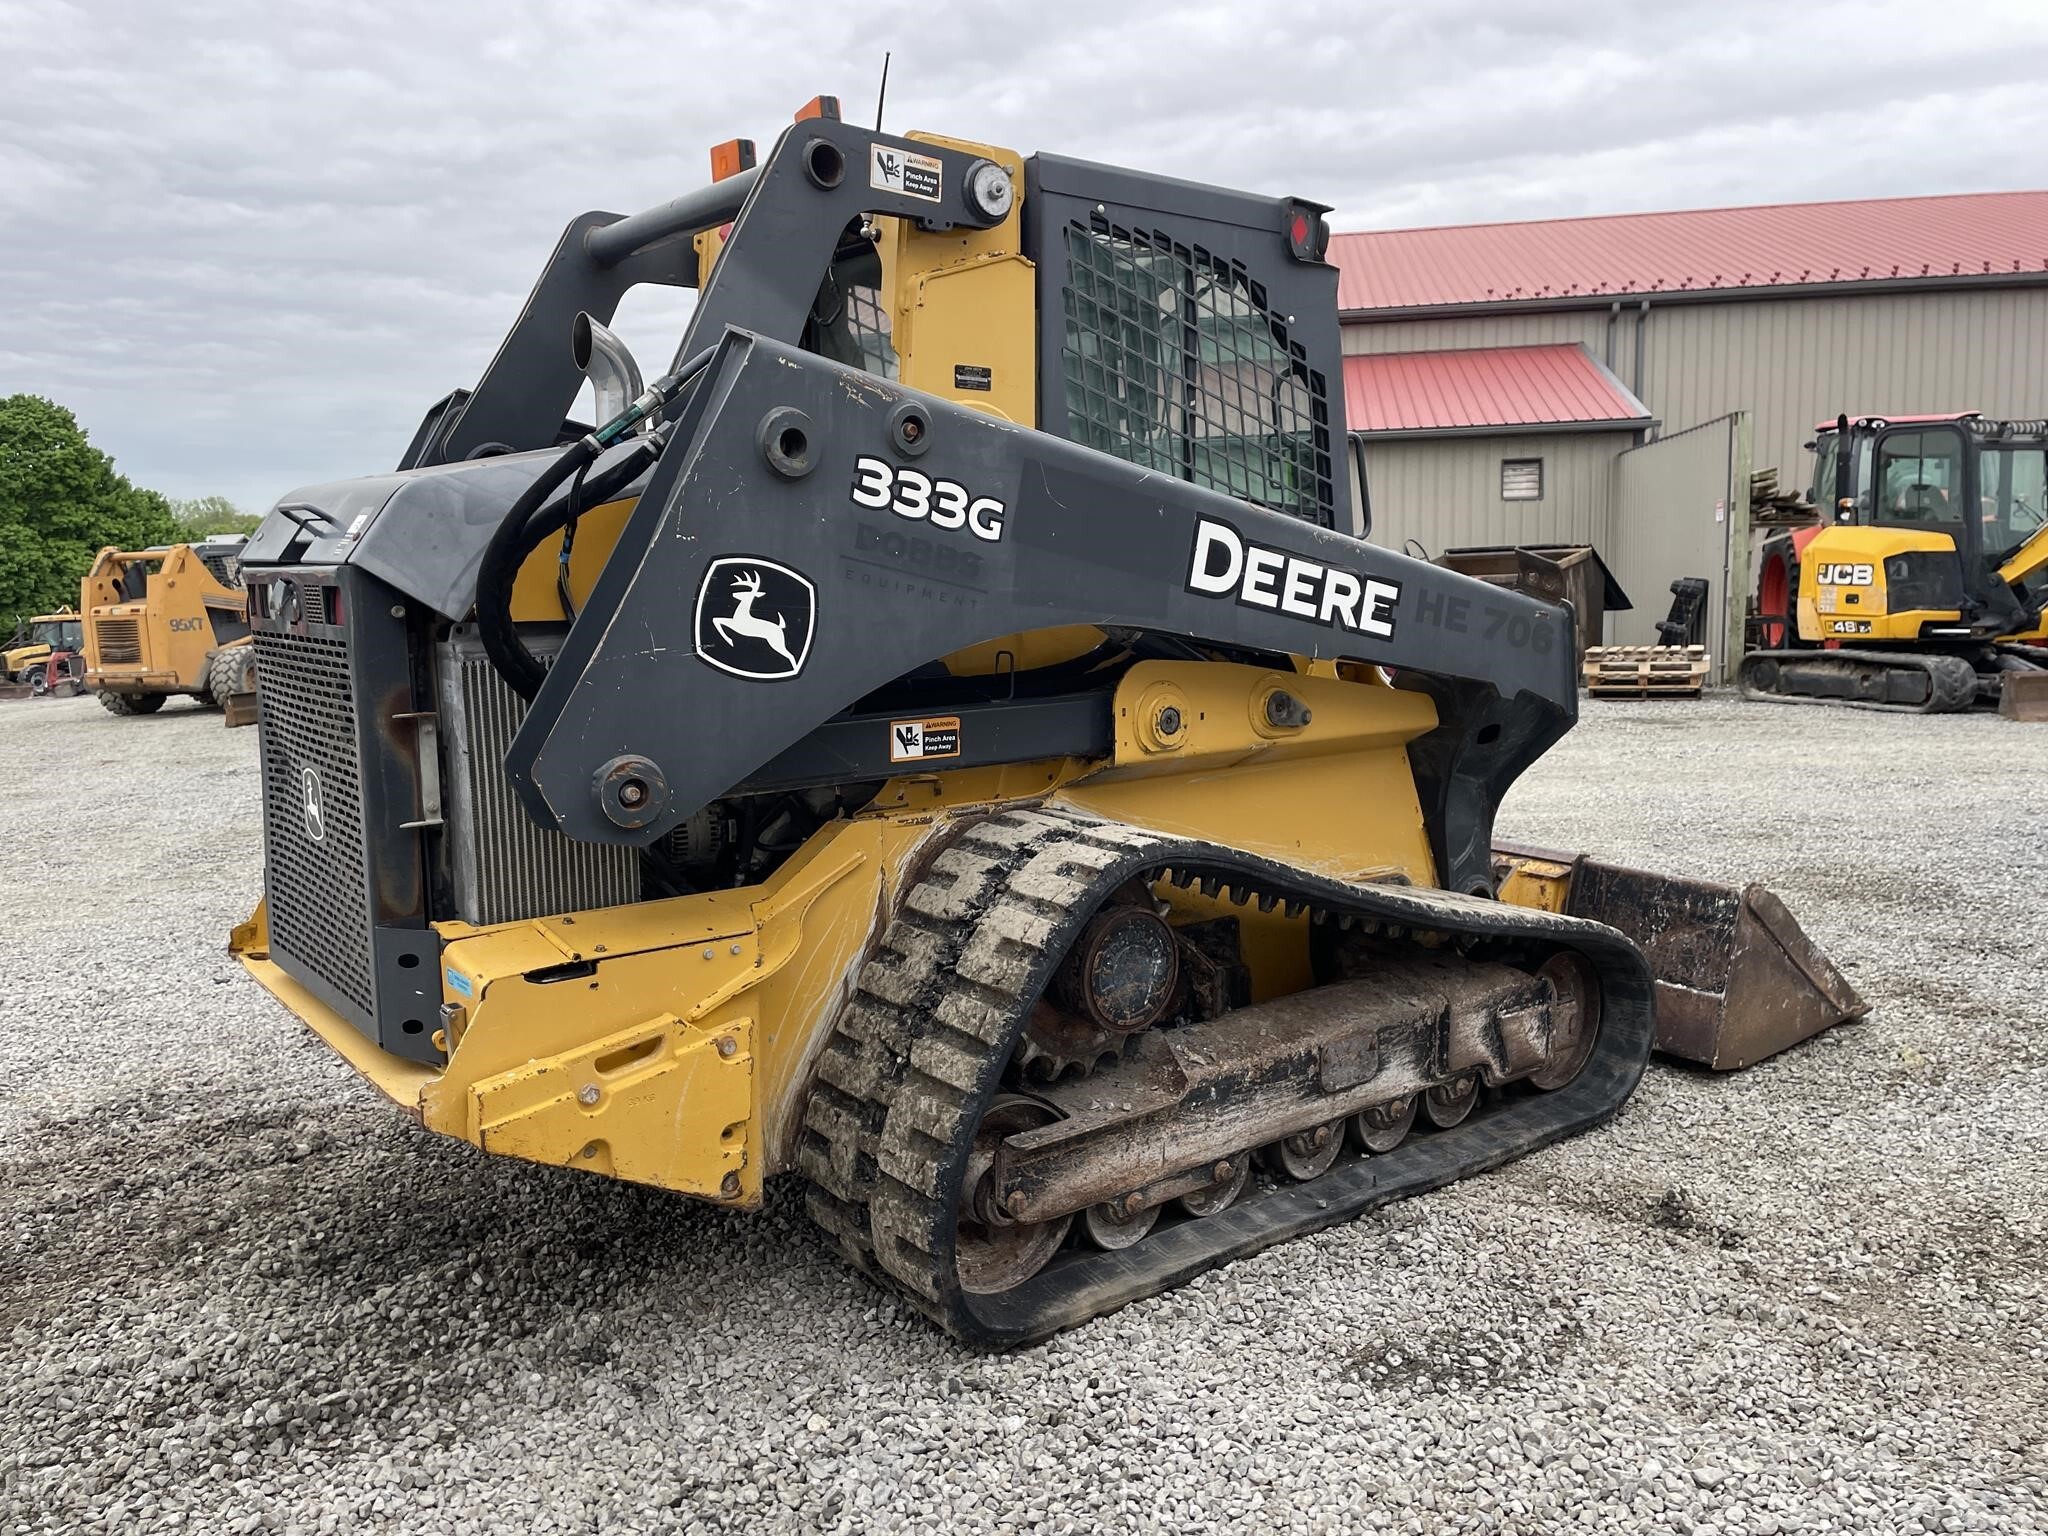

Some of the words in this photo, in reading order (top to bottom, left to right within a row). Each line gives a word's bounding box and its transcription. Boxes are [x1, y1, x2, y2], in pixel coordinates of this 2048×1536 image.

[912, 157, 939, 169] WARNING
[905, 171, 923, 181] Pinch
[923, 175, 938, 185] Area
[905, 180, 919, 190] Keep
[919, 184, 934, 193] Away
[852, 457, 1004, 541] 333G
[1189, 519, 1399, 637] DEERE
[1818, 564, 1873, 585] JCB
[845, 569, 978, 608] EQUIPMENT
[1415, 587, 1472, 634] HE
[1482, 606, 1555, 655] 706
[1834, 621, 1857, 633] 48
[924, 735, 942, 743] Pinch
